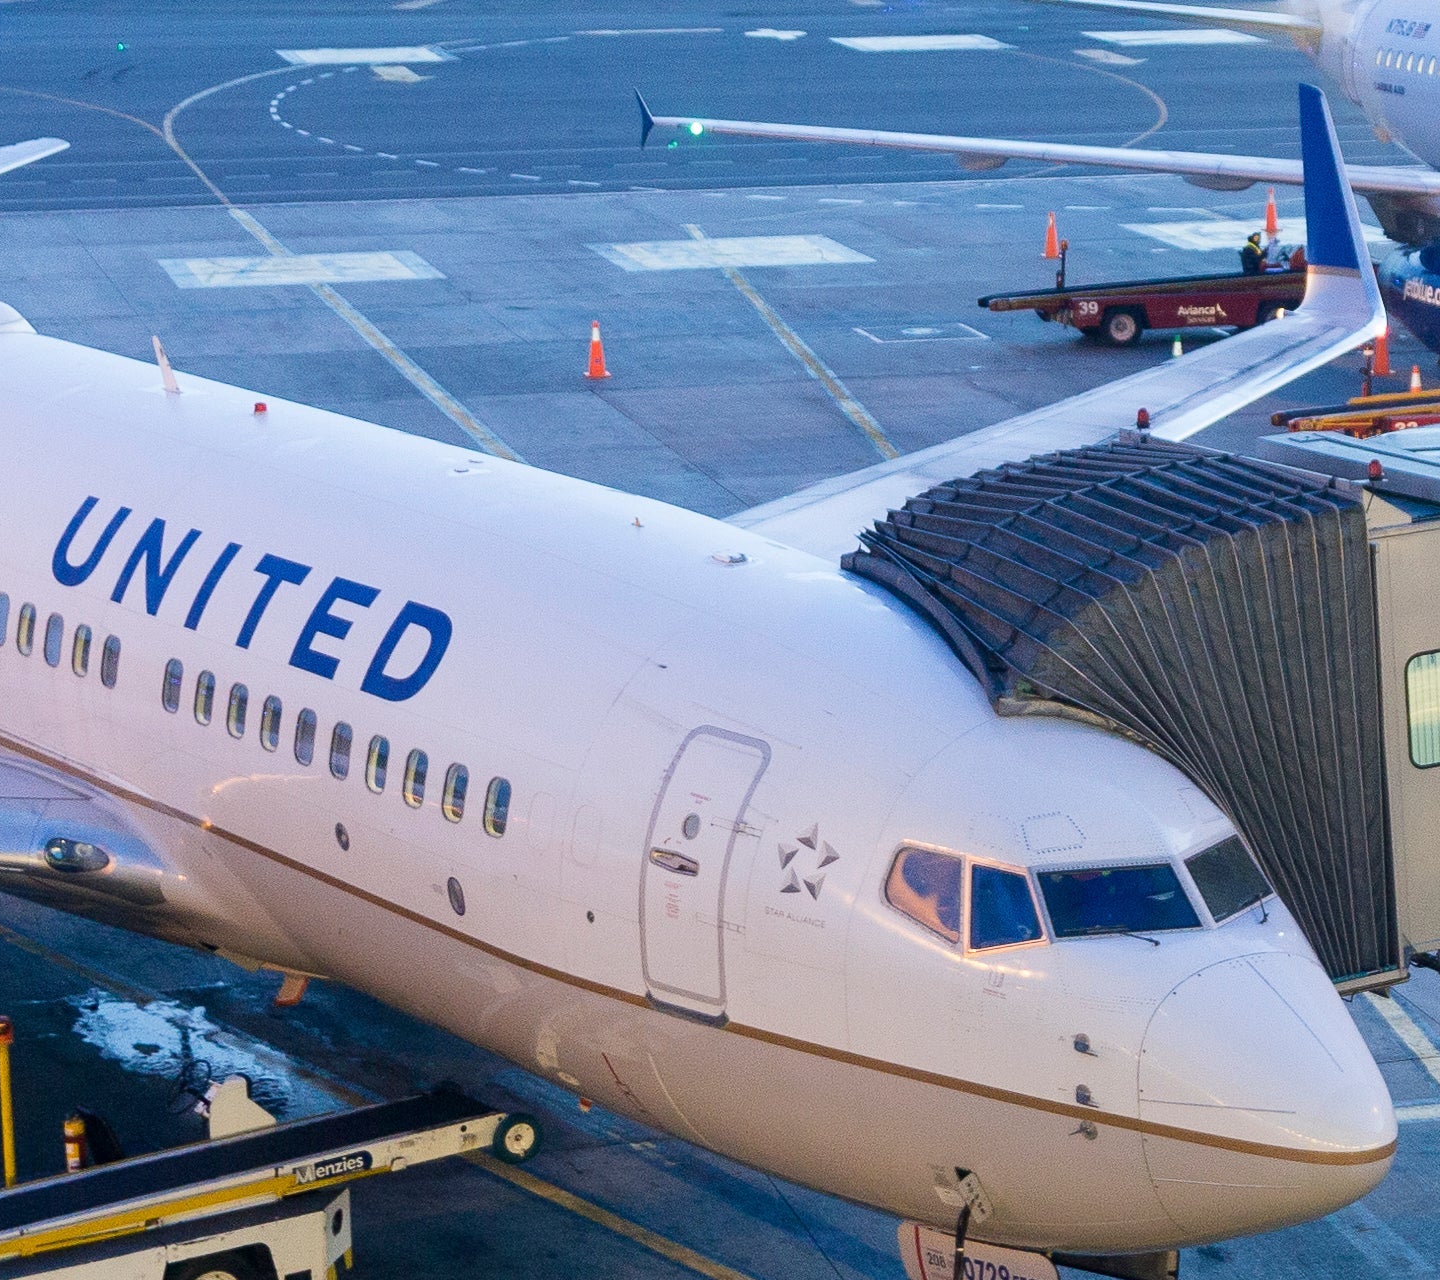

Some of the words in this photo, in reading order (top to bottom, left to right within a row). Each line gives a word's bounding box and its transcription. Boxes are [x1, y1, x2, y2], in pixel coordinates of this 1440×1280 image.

[1078, 301, 1099, 315] 39
[1177, 305, 1216, 317] Avianca
[51, 496, 453, 702] UNITED
[295, 1155, 364, 1186] Menzies
